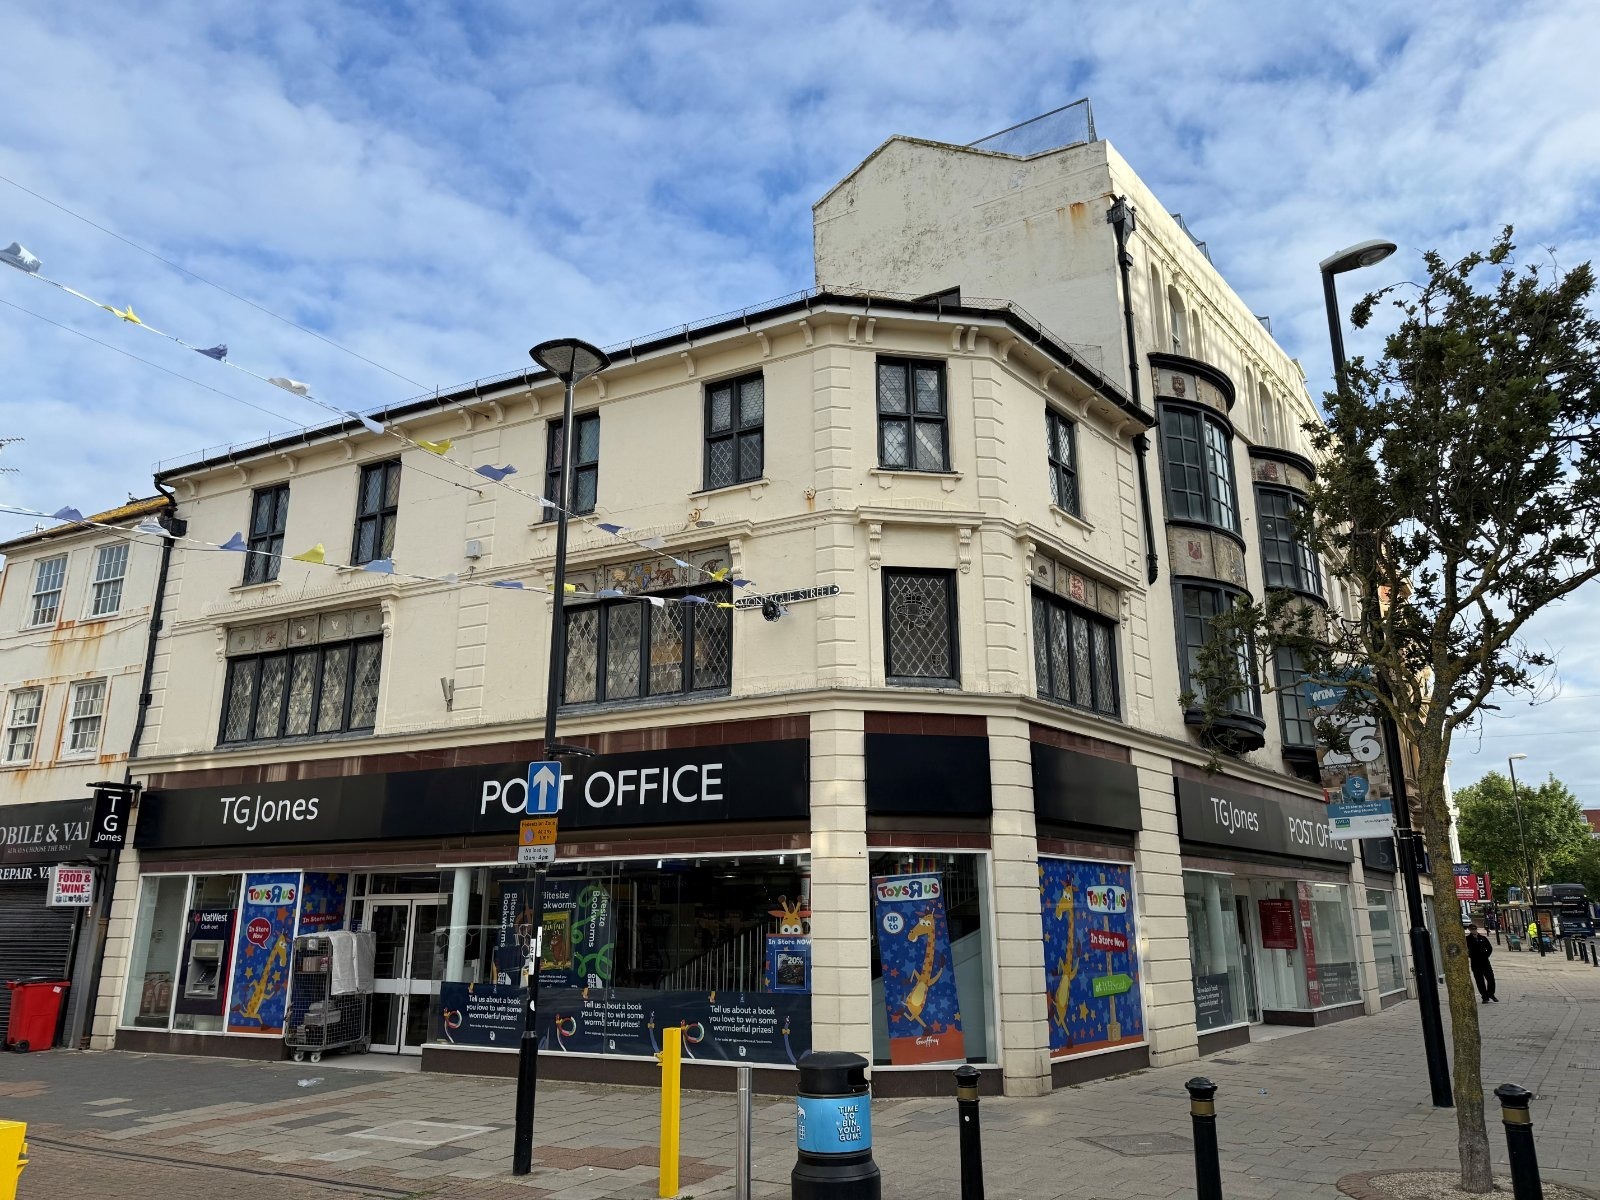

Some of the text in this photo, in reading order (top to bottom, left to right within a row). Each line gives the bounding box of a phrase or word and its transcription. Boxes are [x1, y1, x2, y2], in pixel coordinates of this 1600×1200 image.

[800, 586, 833, 599] STREET
[480, 763, 724, 815] POT OFFICE
[108, 796, 121, 813] T
[104, 815, 118, 832] G
[46, 824, 59, 843] &
[1288, 817, 1314, 846] POST
[95, 832, 122, 843] Jones
[58, 873, 91, 883] FOOD &
[61, 884, 86, 893] WINE
[1480, 889, 1486, 898] TO
[510, 893, 518, 928] Bitesize
[201, 913, 228, 922] NatWest
[501, 894, 510, 948] Bookworms
[589, 890, 600, 948] Bookworms
[888, 922, 899, 930] to
[1091, 933, 1125, 948] In Store Now
[788, 957, 804, 965] 20%
[469, 995, 477, 1003] Tell
[486, 996, 502, 1004] about
[507, 997, 521, 1005] book
[602, 1002, 621, 1010] about
[627, 1002, 642, 1010] book
[710, 1005, 722, 1013] Tell
[732, 1006, 752, 1014] about
[758, 1007, 776, 1015] book
[616, 1011, 626, 1019] win
[709, 1016, 720, 1024] you
[722, 1014, 736, 1023] love
[746, 1016, 758, 1024] win
[621, 1021, 641, 1029] prizes!
[714, 1025, 774, 1035] wormderful prizes!
[839, 1105, 859, 1113] TIME
[838, 1126, 861, 1134] YOUR
